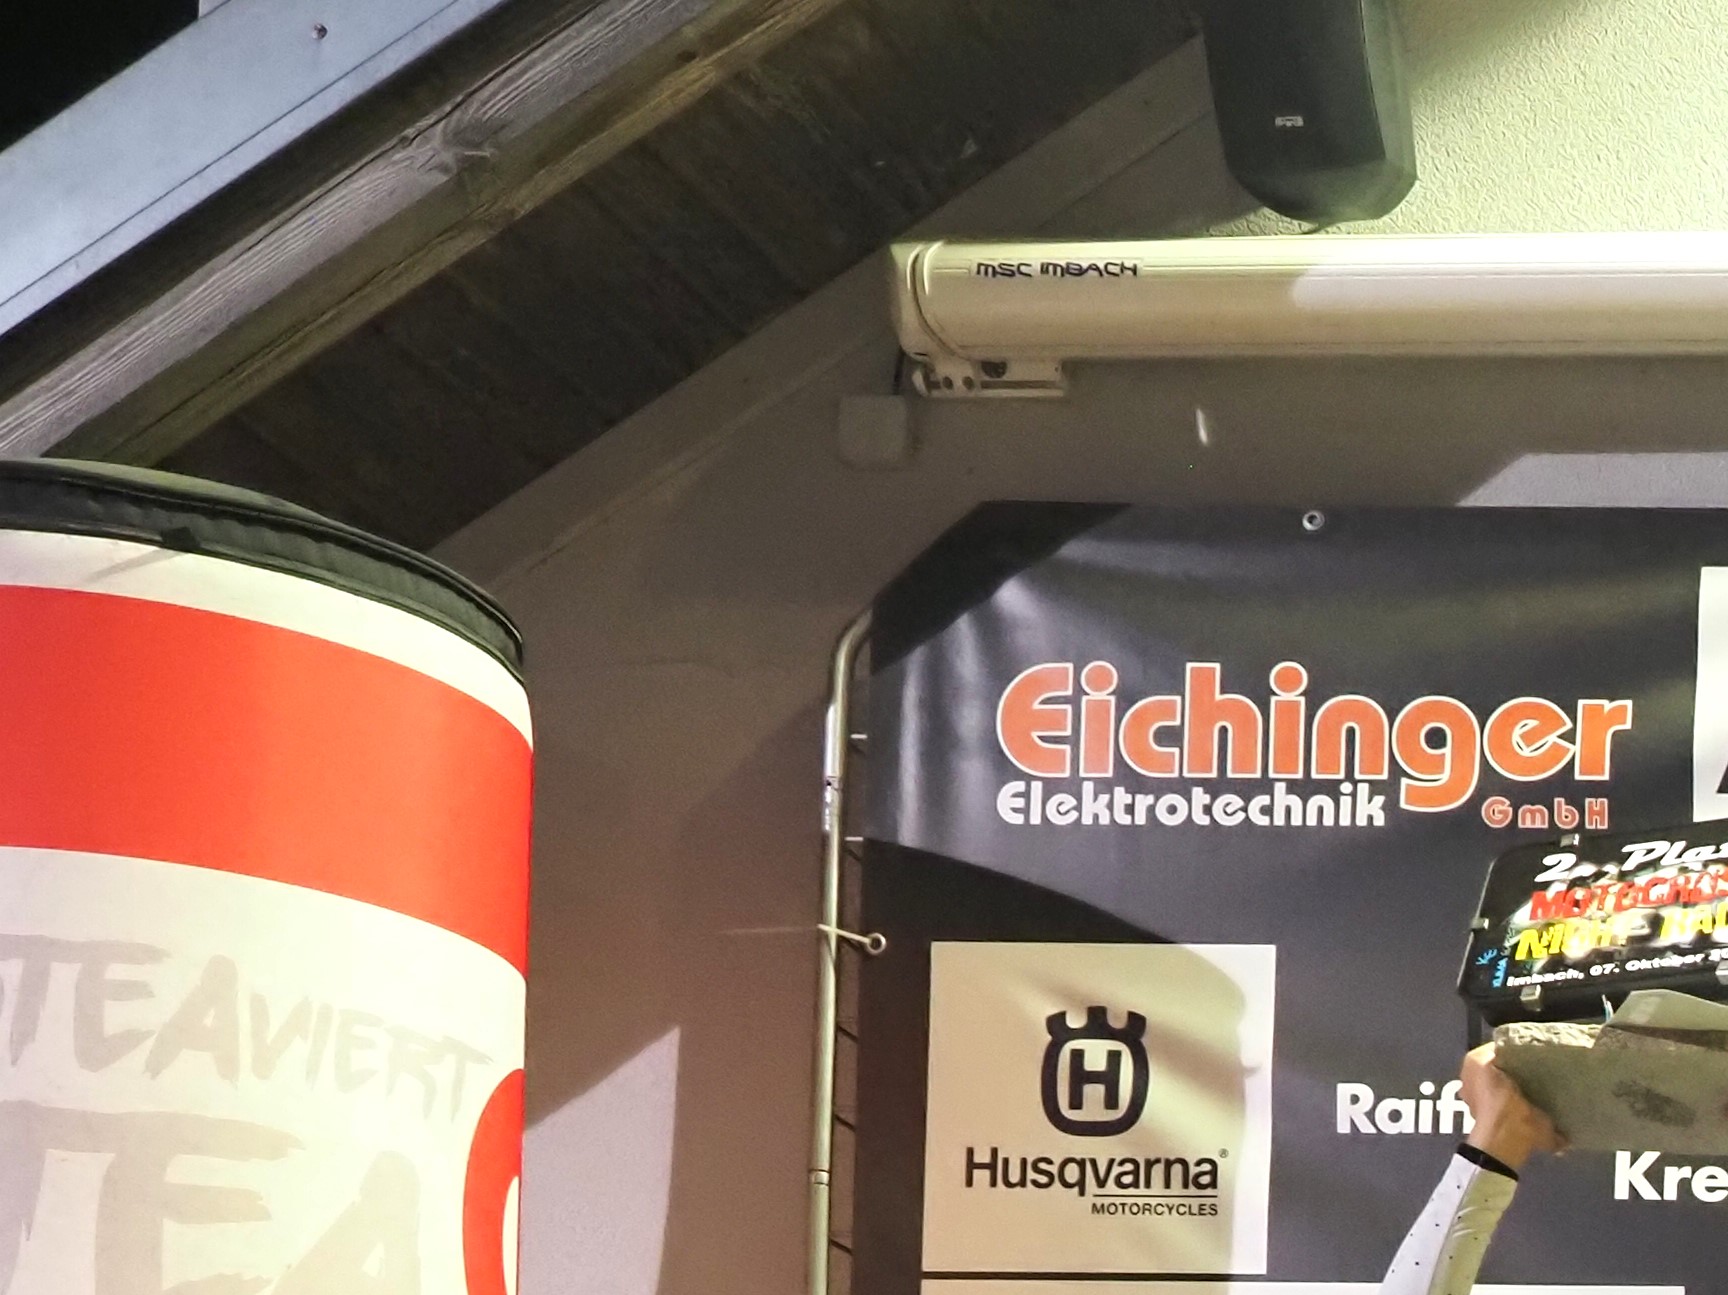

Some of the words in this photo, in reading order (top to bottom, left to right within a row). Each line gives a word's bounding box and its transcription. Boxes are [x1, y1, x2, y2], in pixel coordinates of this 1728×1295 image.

[976, 262, 1032, 278] MSC
[1040, 261, 1138, 278] IMBACH
[996, 662, 1633, 811] Eichinger
[996, 782, 1386, 828] Elektrotechnik
[1482, 797, 1609, 830] GmbH
[1091, 1202, 1219, 1217] MOTORCYCLES
